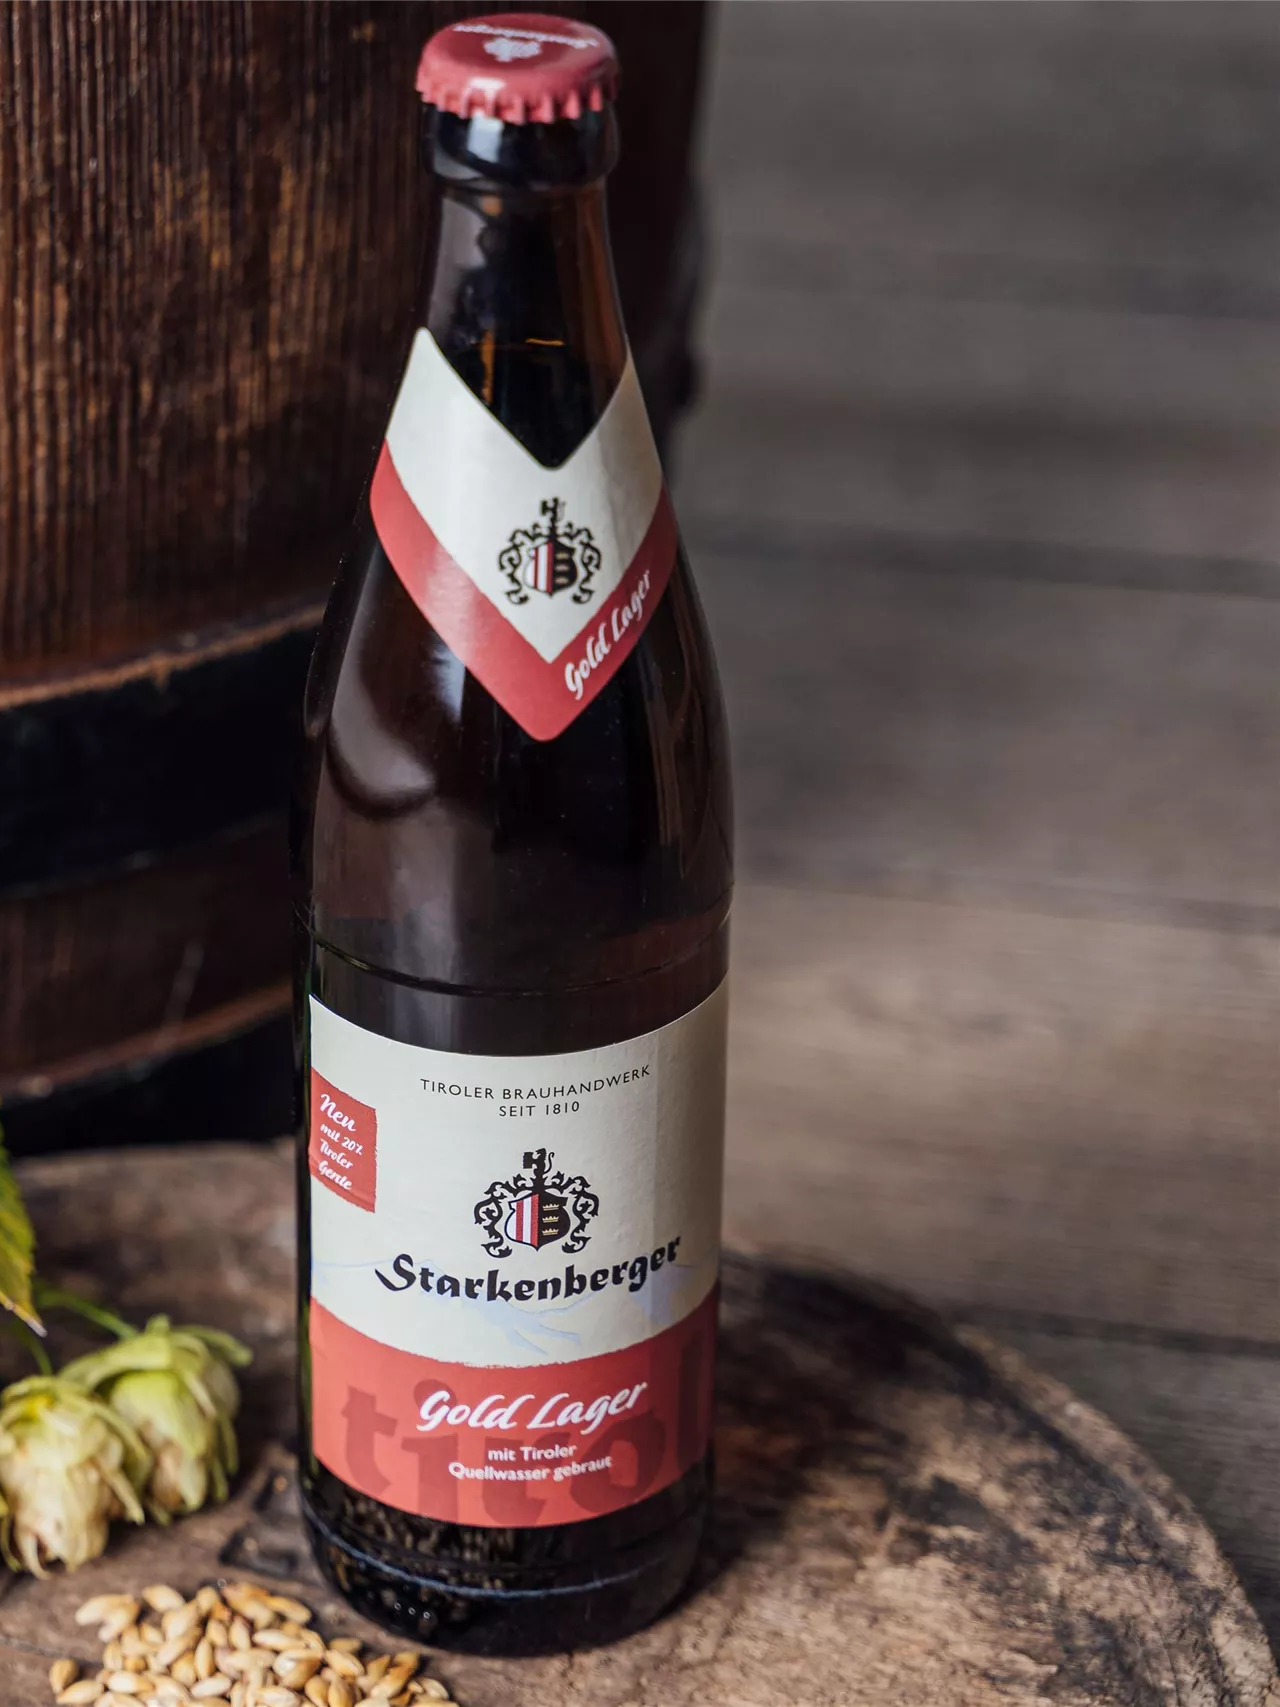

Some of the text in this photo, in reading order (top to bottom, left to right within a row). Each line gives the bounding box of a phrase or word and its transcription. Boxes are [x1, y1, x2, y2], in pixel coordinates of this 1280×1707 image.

[564, 570, 650, 701] Gold Lager
[420, 1064, 651, 1100] TIROLER BRAUHANDWERK
[320, 1093, 356, 1132] Neu
[499, 1100, 580, 1117] SEIT 1810
[320, 1123, 363, 1155] mit 20%
[320, 1137, 354, 1169] Tiroler
[374, 1235, 682, 1302] Starkenberger
[416, 1381, 649, 1436] Gold Lager
[448, 1456, 613, 1482] Quellwasser gebraut
[488, 1444, 577, 1462] mit Tiroler
